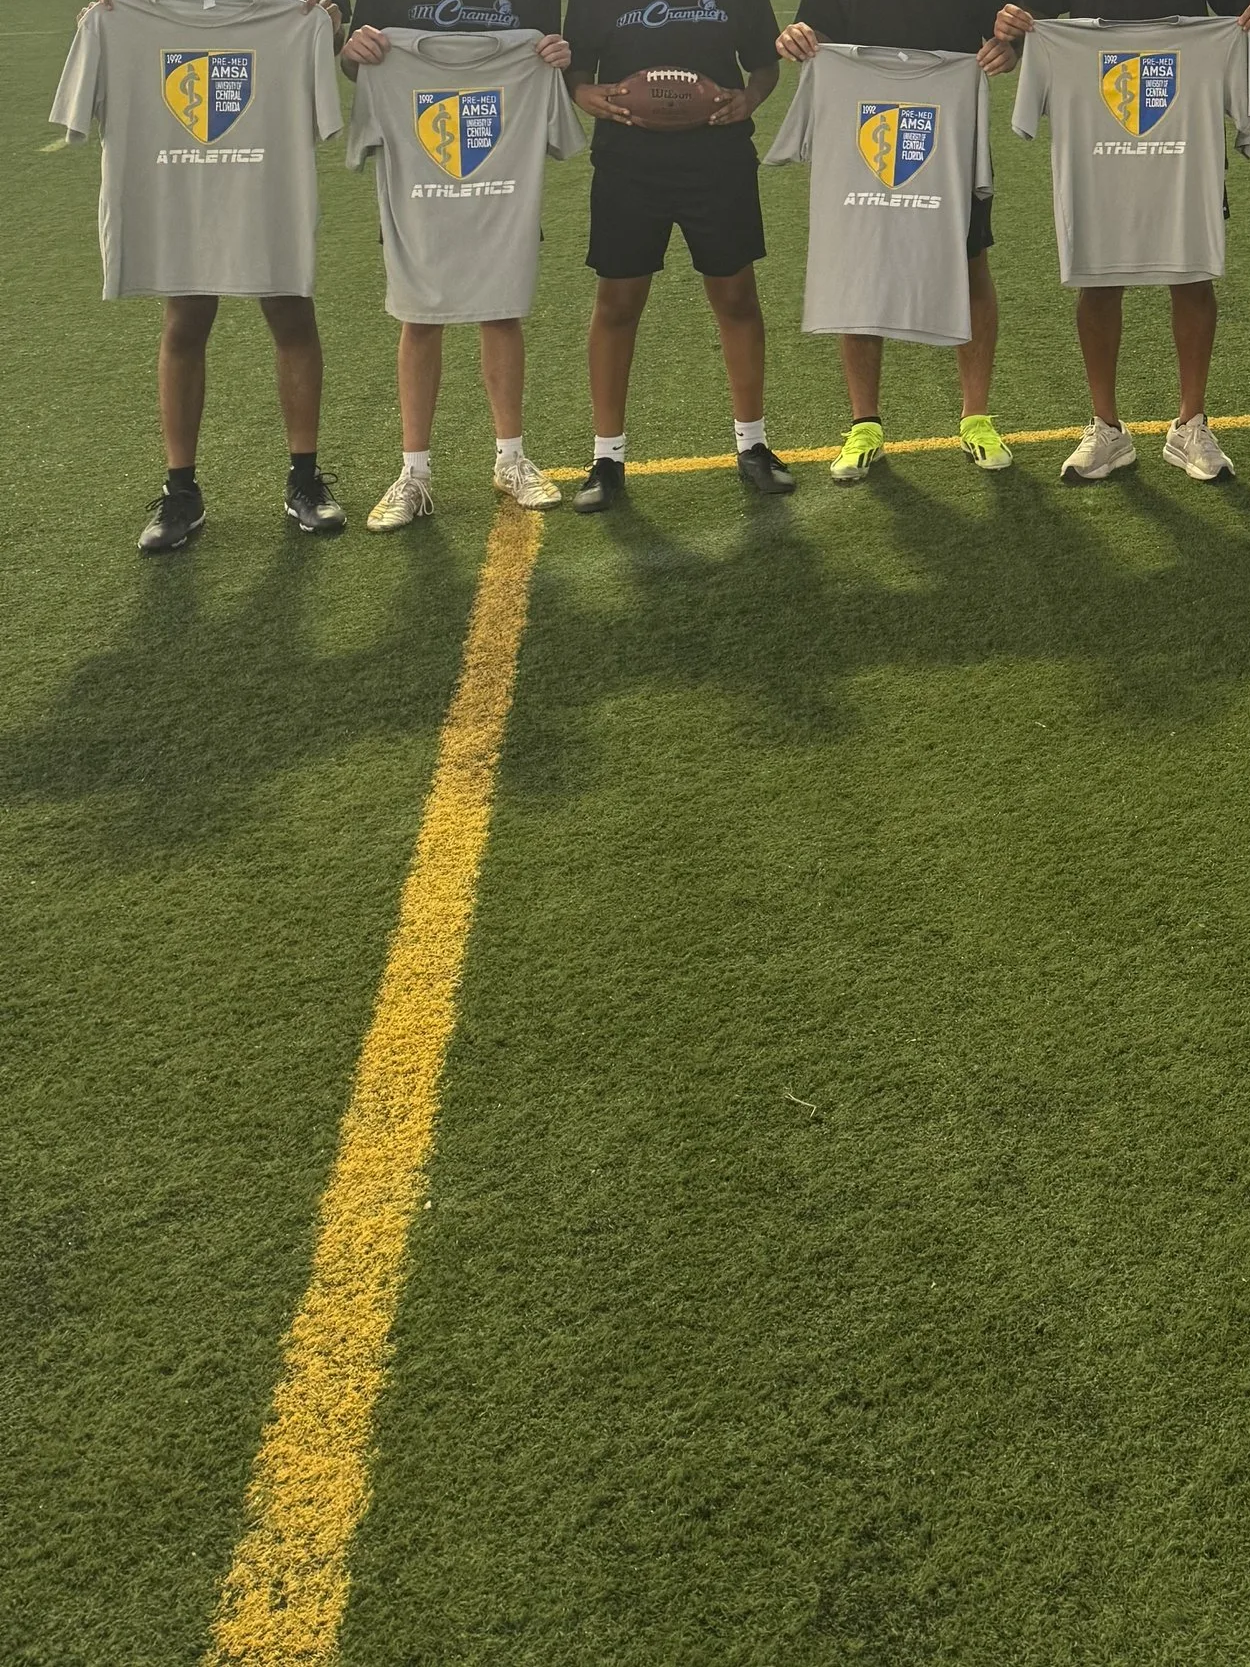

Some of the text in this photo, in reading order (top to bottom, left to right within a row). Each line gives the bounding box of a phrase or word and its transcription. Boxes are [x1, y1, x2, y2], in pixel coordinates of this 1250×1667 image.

[642, 0, 728, 26] Champion
[166, 54, 182, 64] 1992
[212, 57, 248, 66] PRE-MED
[1104, 55, 1118, 64] 1992
[1142, 58, 1174, 66] PRE-MED
[211, 66, 248, 78] AMSA
[1142, 66, 1174, 77] AMSA
[215, 90, 242, 101] CENTRAL
[651, 88, 692, 100] Wilson
[1145, 88, 1169, 97] CENTRAL
[418, 95, 434, 104] 1992
[461, 95, 497, 104] PRE-MED
[1145, 98, 1167, 108] FLORIDA
[215, 102, 240, 112] FLORIDA
[461, 104, 497, 116] AMSA
[862, 105, 876, 114] 1992
[901, 109, 933, 120] PRE-MED
[900, 119, 932, 131] AMSA
[467, 127, 493, 137] CENTRAL
[467, 138, 492, 149] FLORIDA
[902, 141, 925, 151] CENTRAL
[1093, 141, 1187, 155] ATHLETICS
[156, 149, 265, 164] ATHLETICS
[901, 151, 924, 161] FLORIDA
[411, 180, 516, 198] ATHLETICS
[843, 192, 942, 209] ATHLETICS
